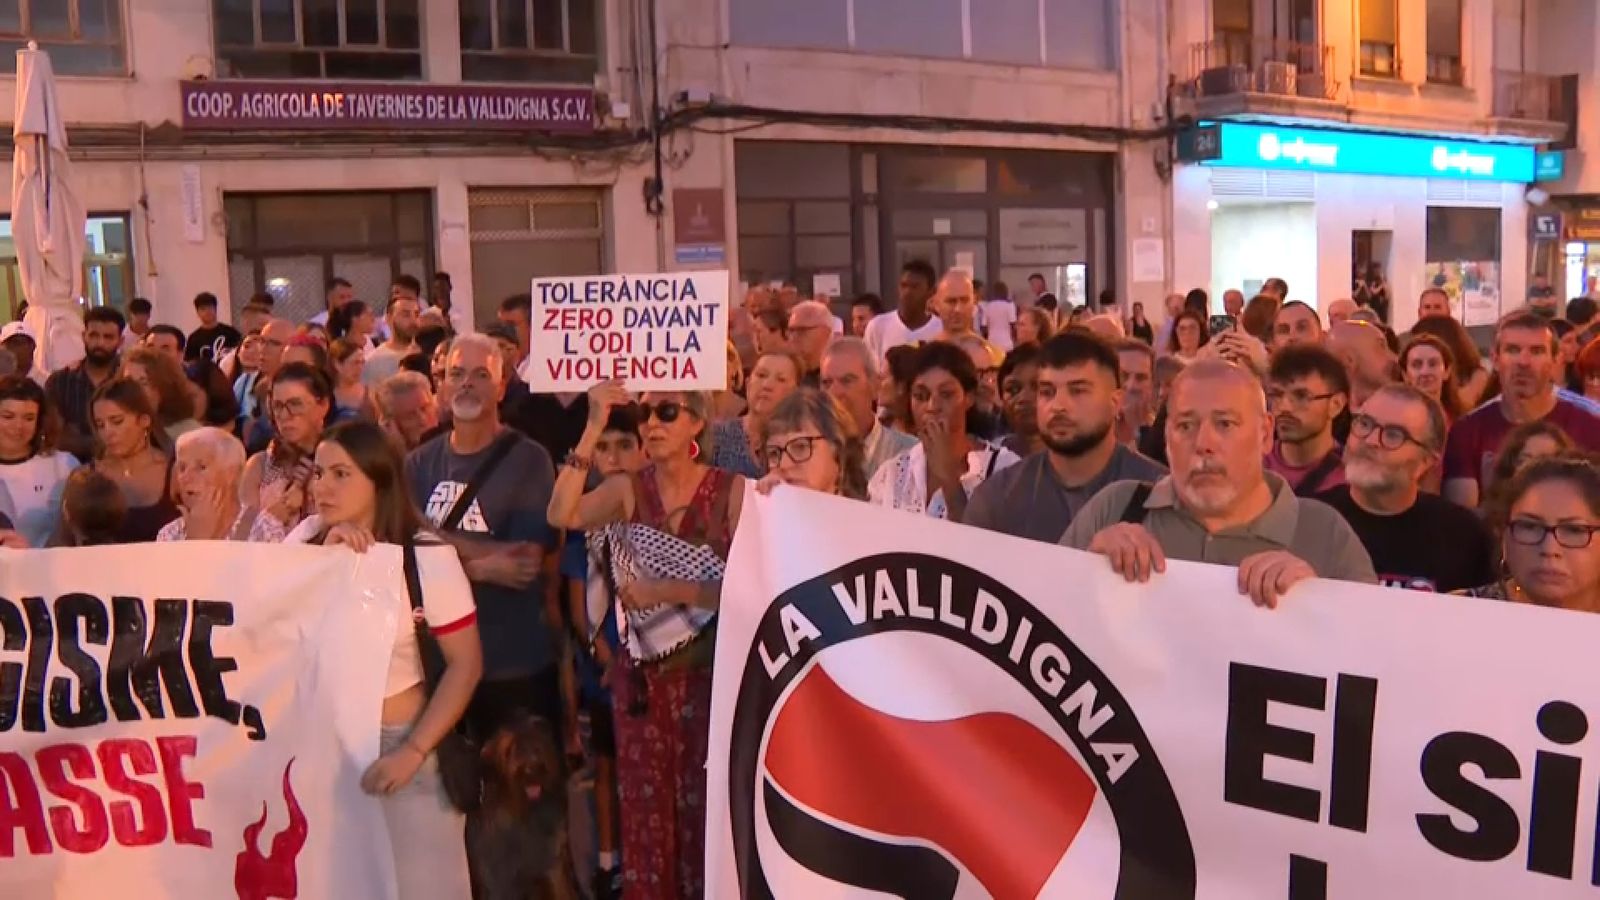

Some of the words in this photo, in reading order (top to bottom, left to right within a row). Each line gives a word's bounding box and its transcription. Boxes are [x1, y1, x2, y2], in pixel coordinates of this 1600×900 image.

[187, 92, 237, 118] COOP.
[241, 92, 320, 118] AGRICOLA
[323, 92, 344, 118] DE
[347, 93, 423, 119] TAVERNES
[426, 94, 446, 119] DE
[449, 95, 467, 119] LA
[469, 95, 549, 121] VALLDIGNA
[552, 97, 591, 121] S.C.V.
[537, 276, 698, 304] TOLERÀNCIA
[543, 307, 613, 331] ZERO
[623, 303, 720, 329] DAVANT
[646, 331, 653, 352] I
[665, 330, 701, 353] LA
[547, 353, 698, 381] VIOLÈNCIA
[758, 602, 822, 680] LA
[831, 568, 1140, 785] VALLDIGNA
[1224, 661, 1379, 833] El
[1415, 700, 1600, 887] si
